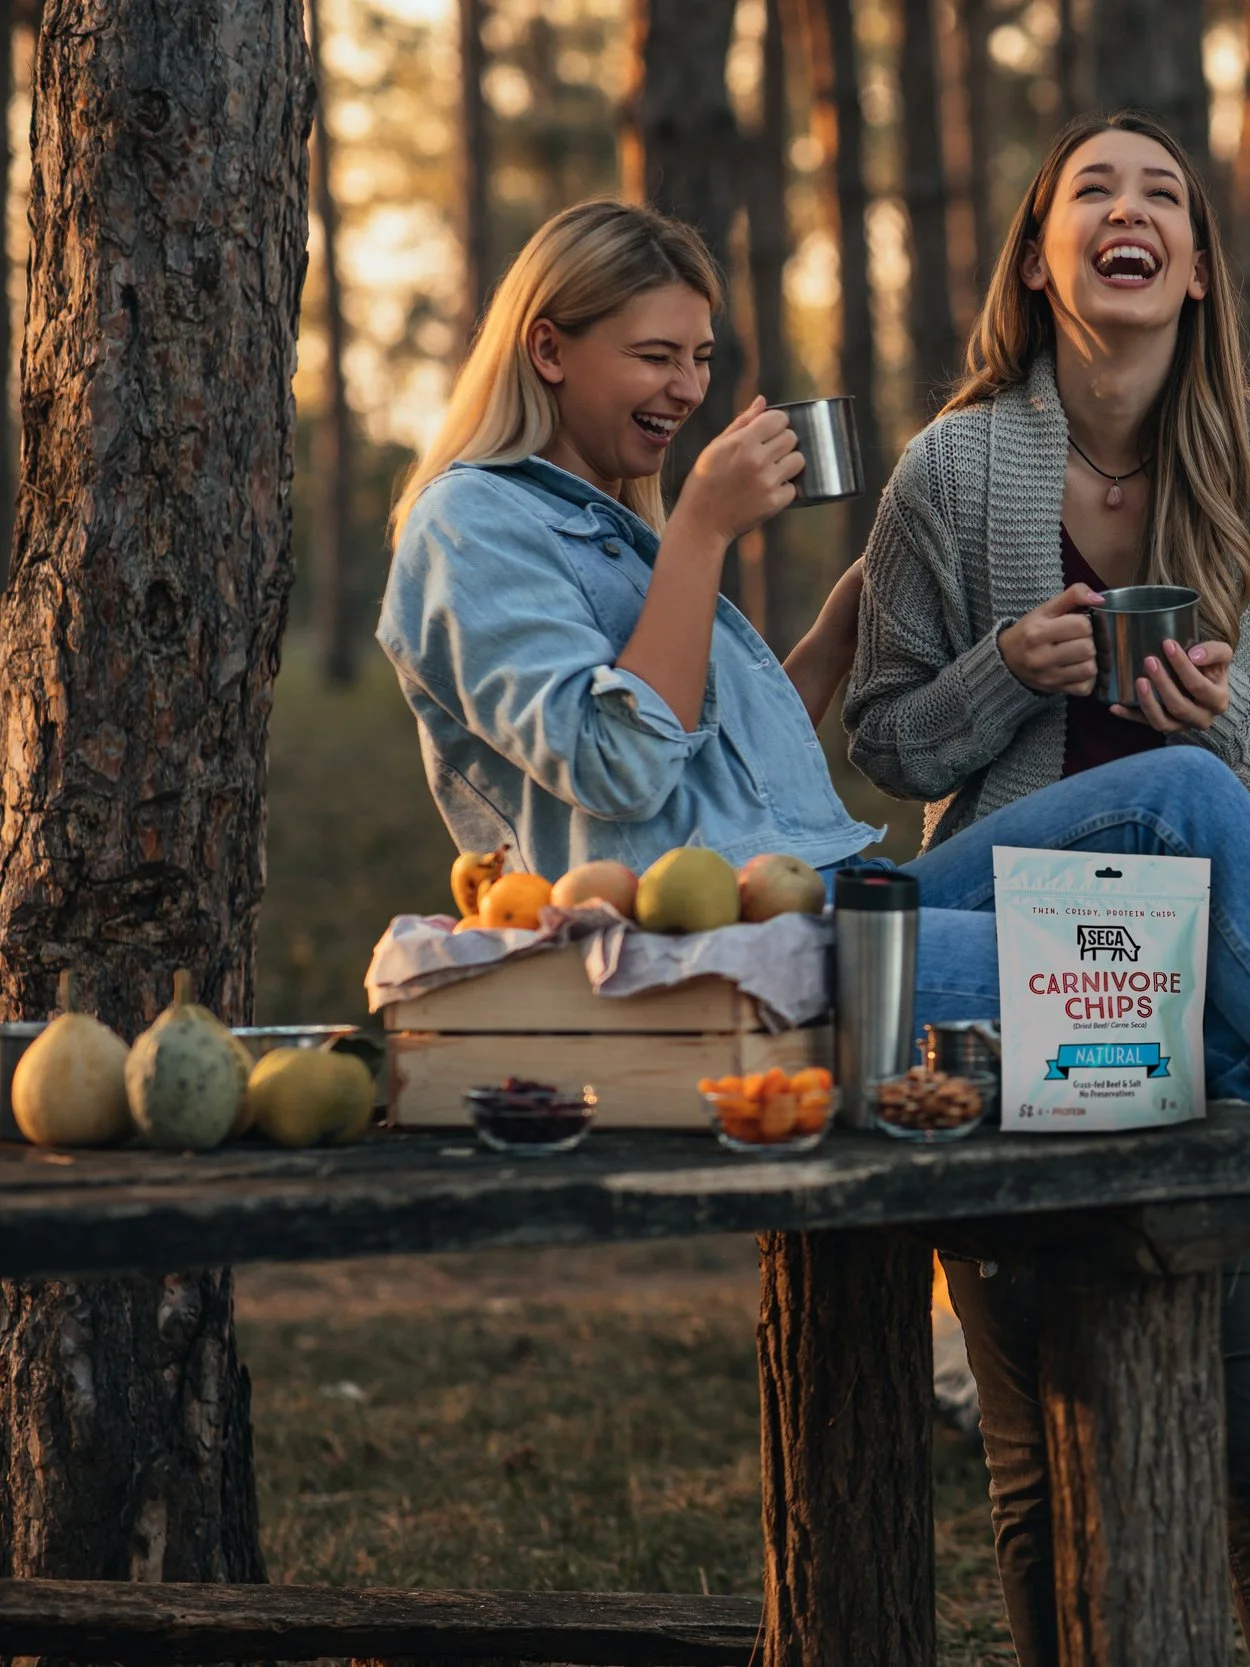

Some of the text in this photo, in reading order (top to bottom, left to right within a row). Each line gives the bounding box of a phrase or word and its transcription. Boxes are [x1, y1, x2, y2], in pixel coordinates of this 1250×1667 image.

[1032, 907, 1059, 915] THIN,
[1066, 908, 1100, 917] CRISPY,
[1107, 910, 1145, 918] PROTEIN
[1088, 930, 1124, 946] SECA
[1029, 972, 1181, 994] CARNIVORE
[1065, 996, 1153, 1020] CHIPS
[1076, 1047, 1143, 1065] NATURAL
